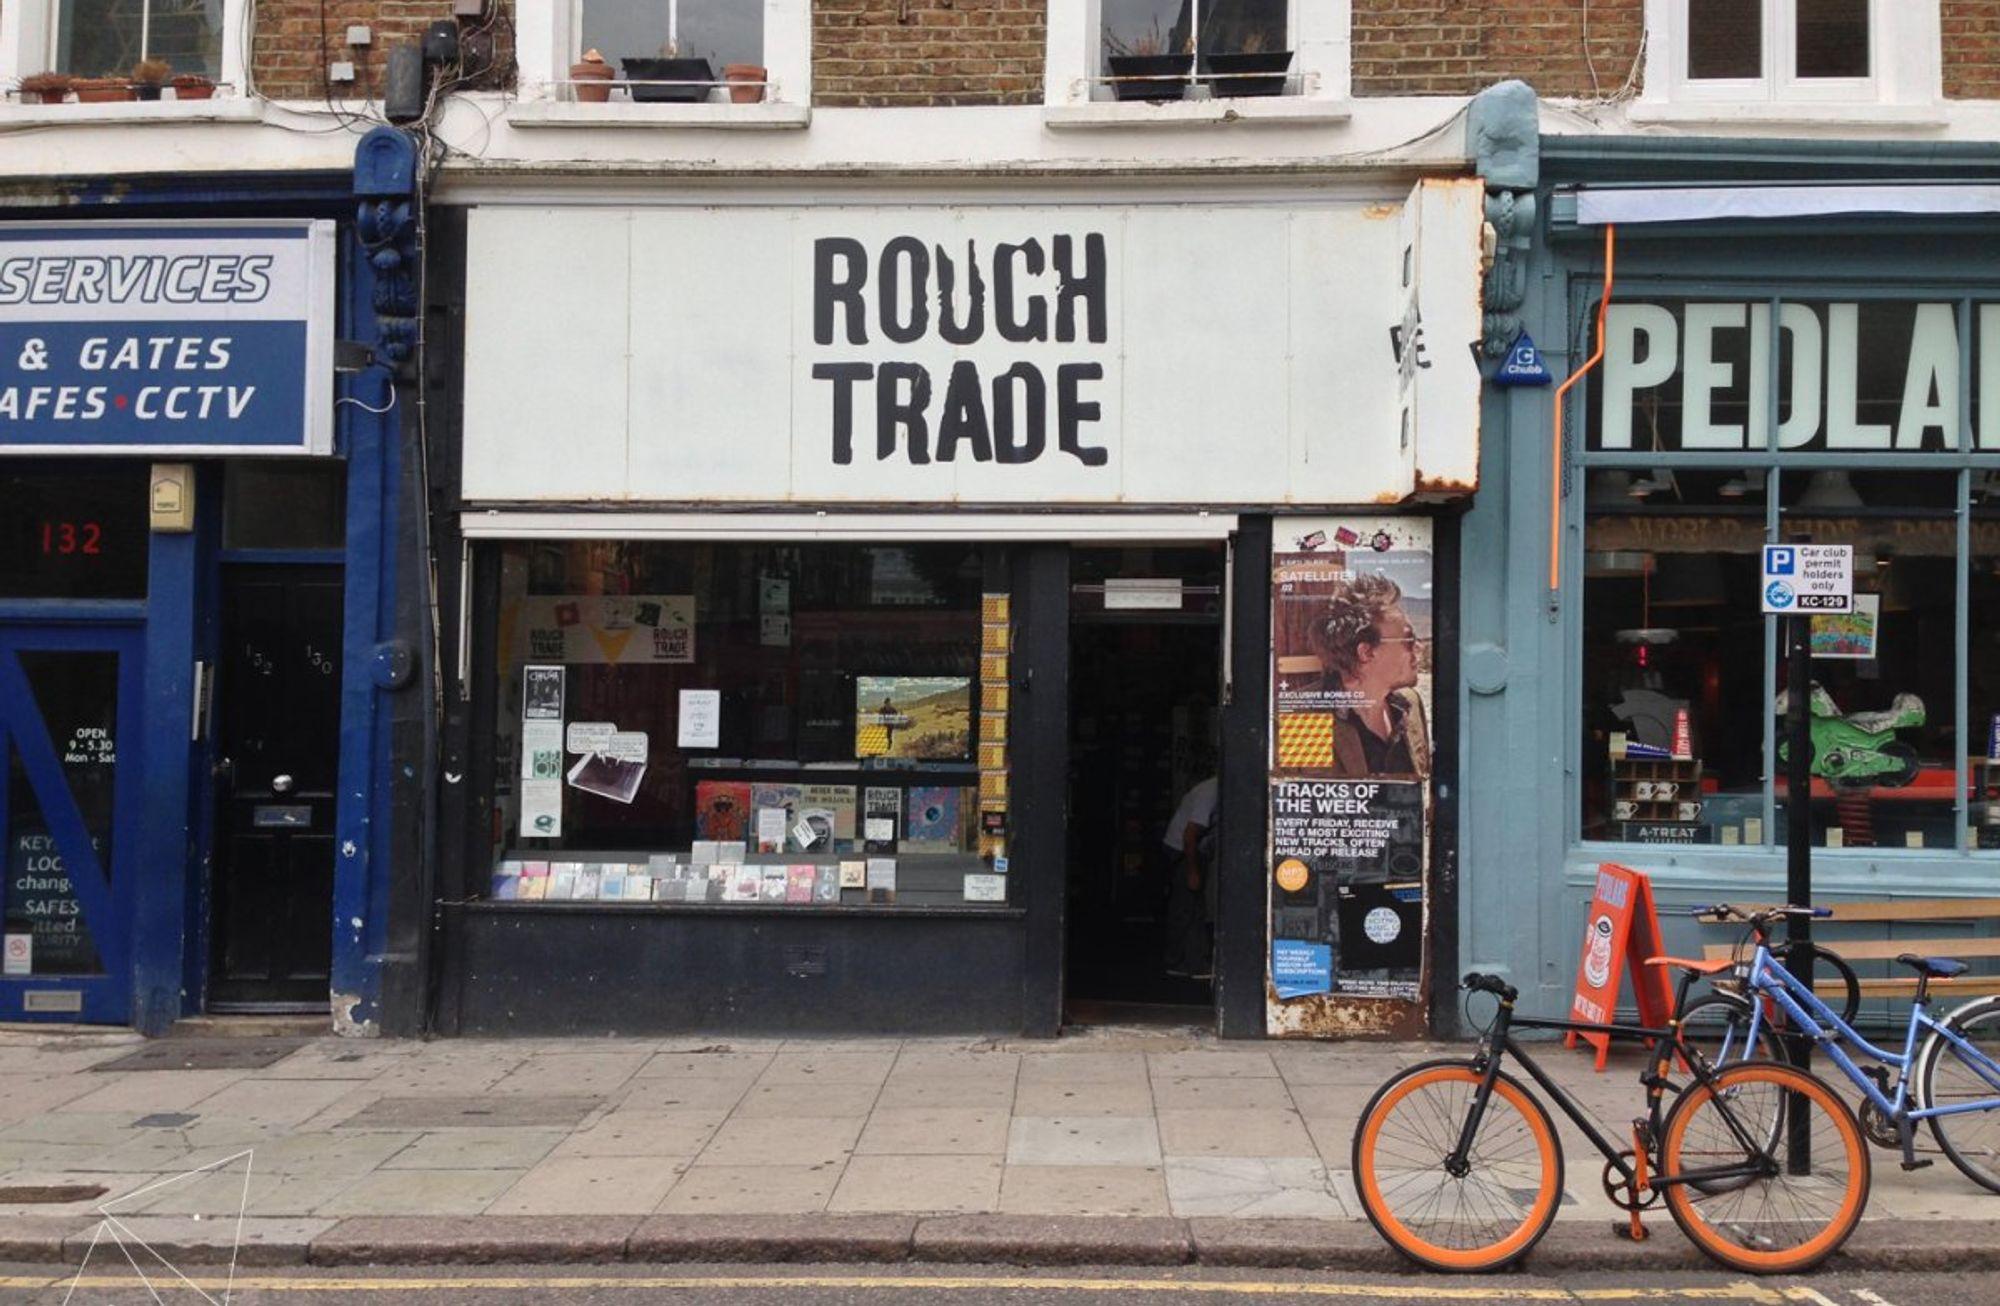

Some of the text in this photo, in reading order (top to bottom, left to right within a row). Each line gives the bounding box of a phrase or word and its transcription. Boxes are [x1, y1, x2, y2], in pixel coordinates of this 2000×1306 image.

[0, 254, 274, 304] SERVICES
[813, 232, 1108, 346] ROUGH
[18, 337, 233, 371] & GATES
[1508, 363, 1543, 374] Chubb
[135, 385, 256, 420] CCTV
[812, 359, 1109, 467] TRADE
[42, 523, 101, 555] 132
[1772, 547, 1847, 573] P Car club
[1805, 559, 1841, 570] permit
[1803, 569, 1844, 579] holders
[1811, 581, 1835, 591] only
[76, 727, 107, 739] OPEN
[69, 739, 77, 750] 9
[65, 752, 88, 763] Mon
[98, 751, 116, 763] Sat
[1277, 782, 1380, 799] TRACKS OF
[1276, 798, 1370, 814] THE WEEK
[1275, 818, 1399, 829] EVERY FRIDAY, RECEIVE
[1275, 828, 1296, 837] THE
[1306, 828, 1337, 838] MOST
[1340, 829, 1390, 838] EXCITING
[1638, 826, 1698, 838] A-TREAT
[20, 835, 57, 851] KEY
[1275, 838, 1385, 848] NEW TRACKS, OFTEN
[1275, 847, 1379, 858] AHEAD OF RELEASE
[27, 856, 66, 872] LOC
[25, 899, 80, 915] SAFES
